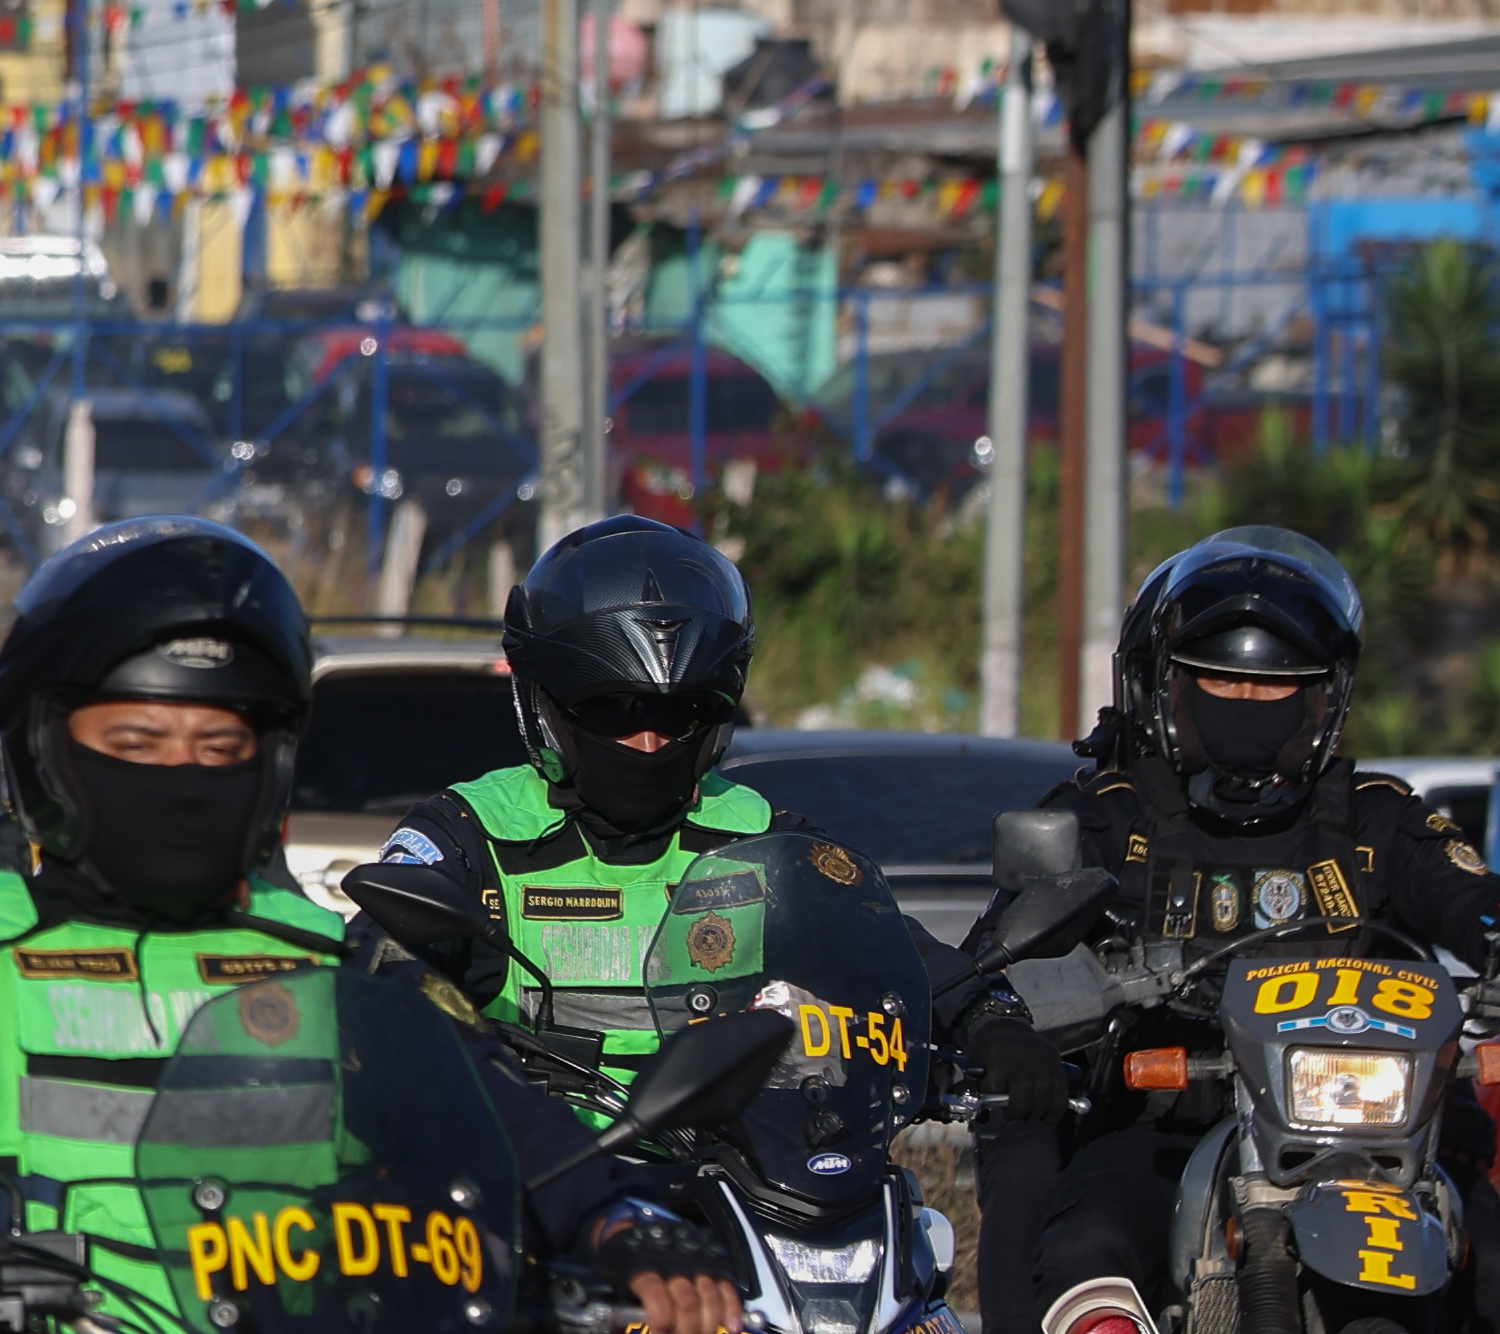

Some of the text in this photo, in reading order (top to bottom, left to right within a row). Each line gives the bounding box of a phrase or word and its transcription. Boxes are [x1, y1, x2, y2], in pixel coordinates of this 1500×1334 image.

[528, 895, 563, 907] SERGIO
[1246, 957, 1440, 989] POLICIA NACIONAL CIVIL
[1254, 968, 1436, 1019] 018
[799, 1004, 909, 1073] DT-54
[187, 1201, 484, 1301] PNC DT-69
